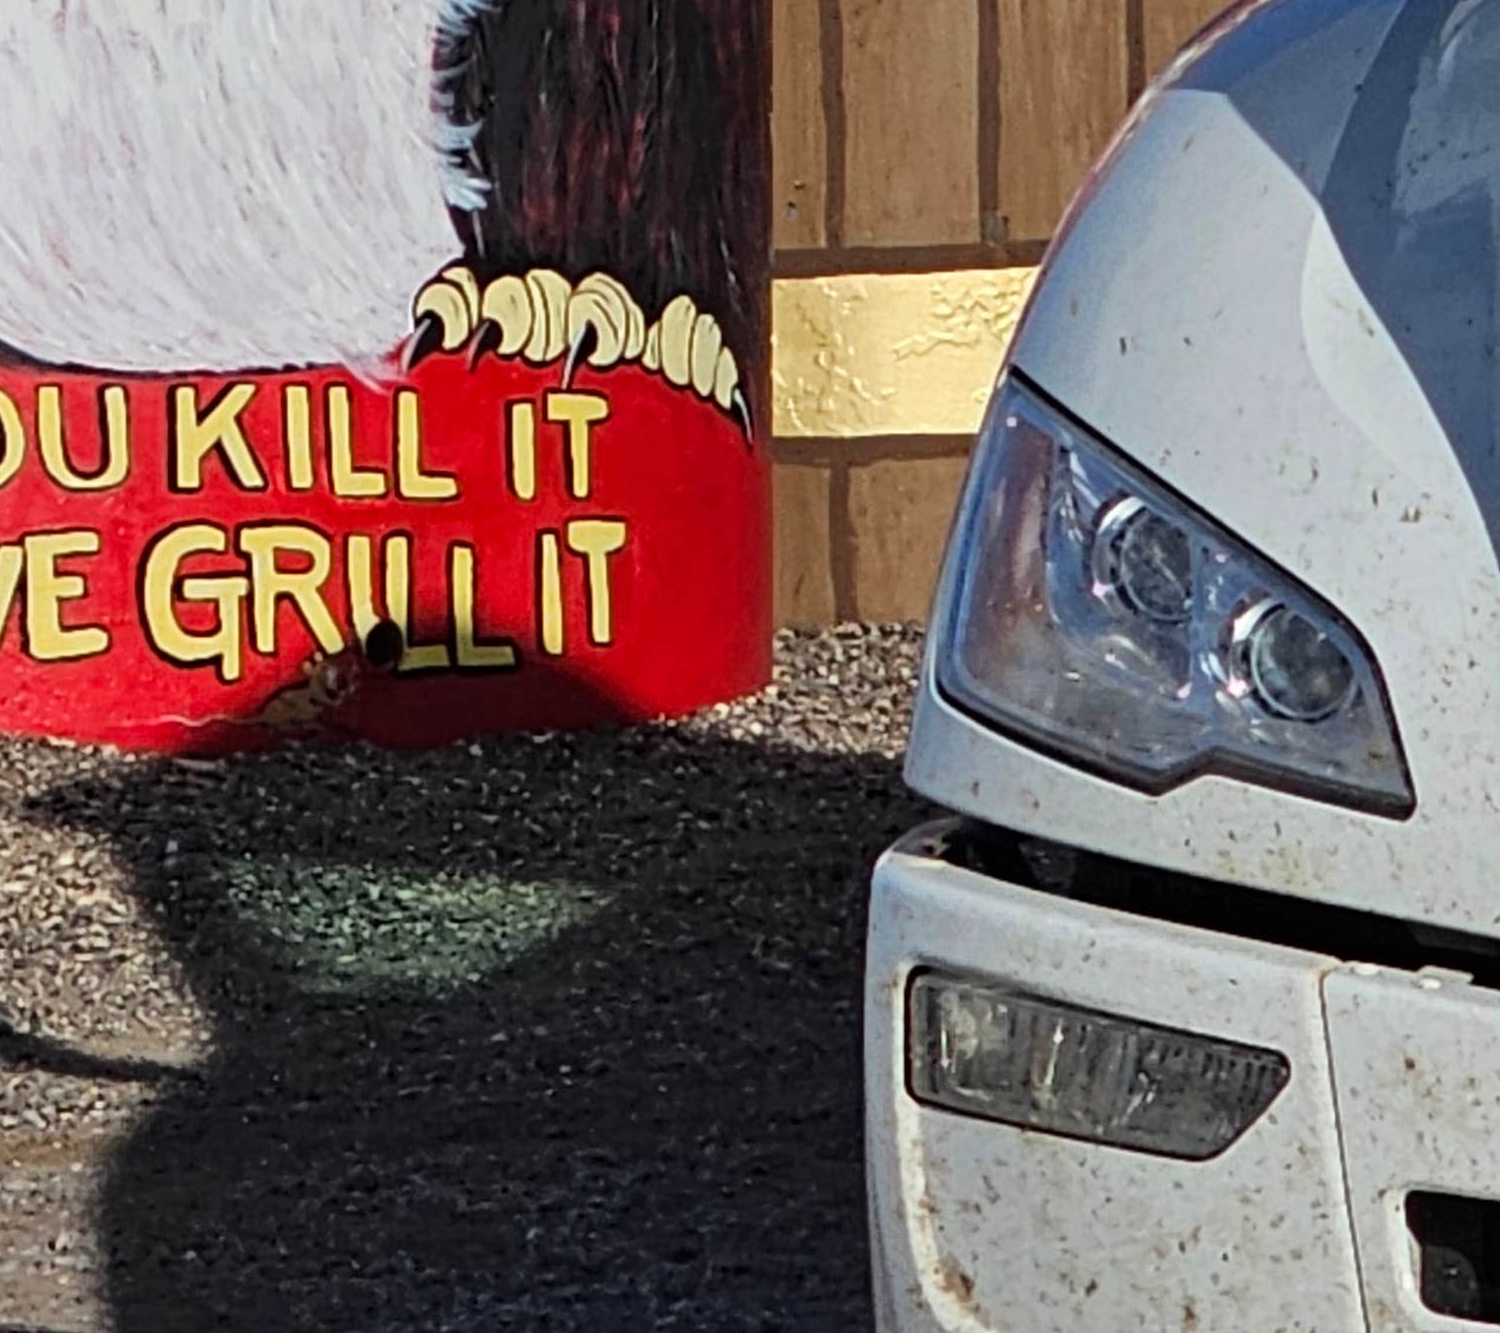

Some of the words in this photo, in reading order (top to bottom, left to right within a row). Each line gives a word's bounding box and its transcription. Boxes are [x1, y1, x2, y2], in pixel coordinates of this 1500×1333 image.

[168, 381, 460, 501] KILL
[506, 389, 612, 501] IT
[136, 521, 520, 683] GRILL
[534, 515, 630, 659] IT
